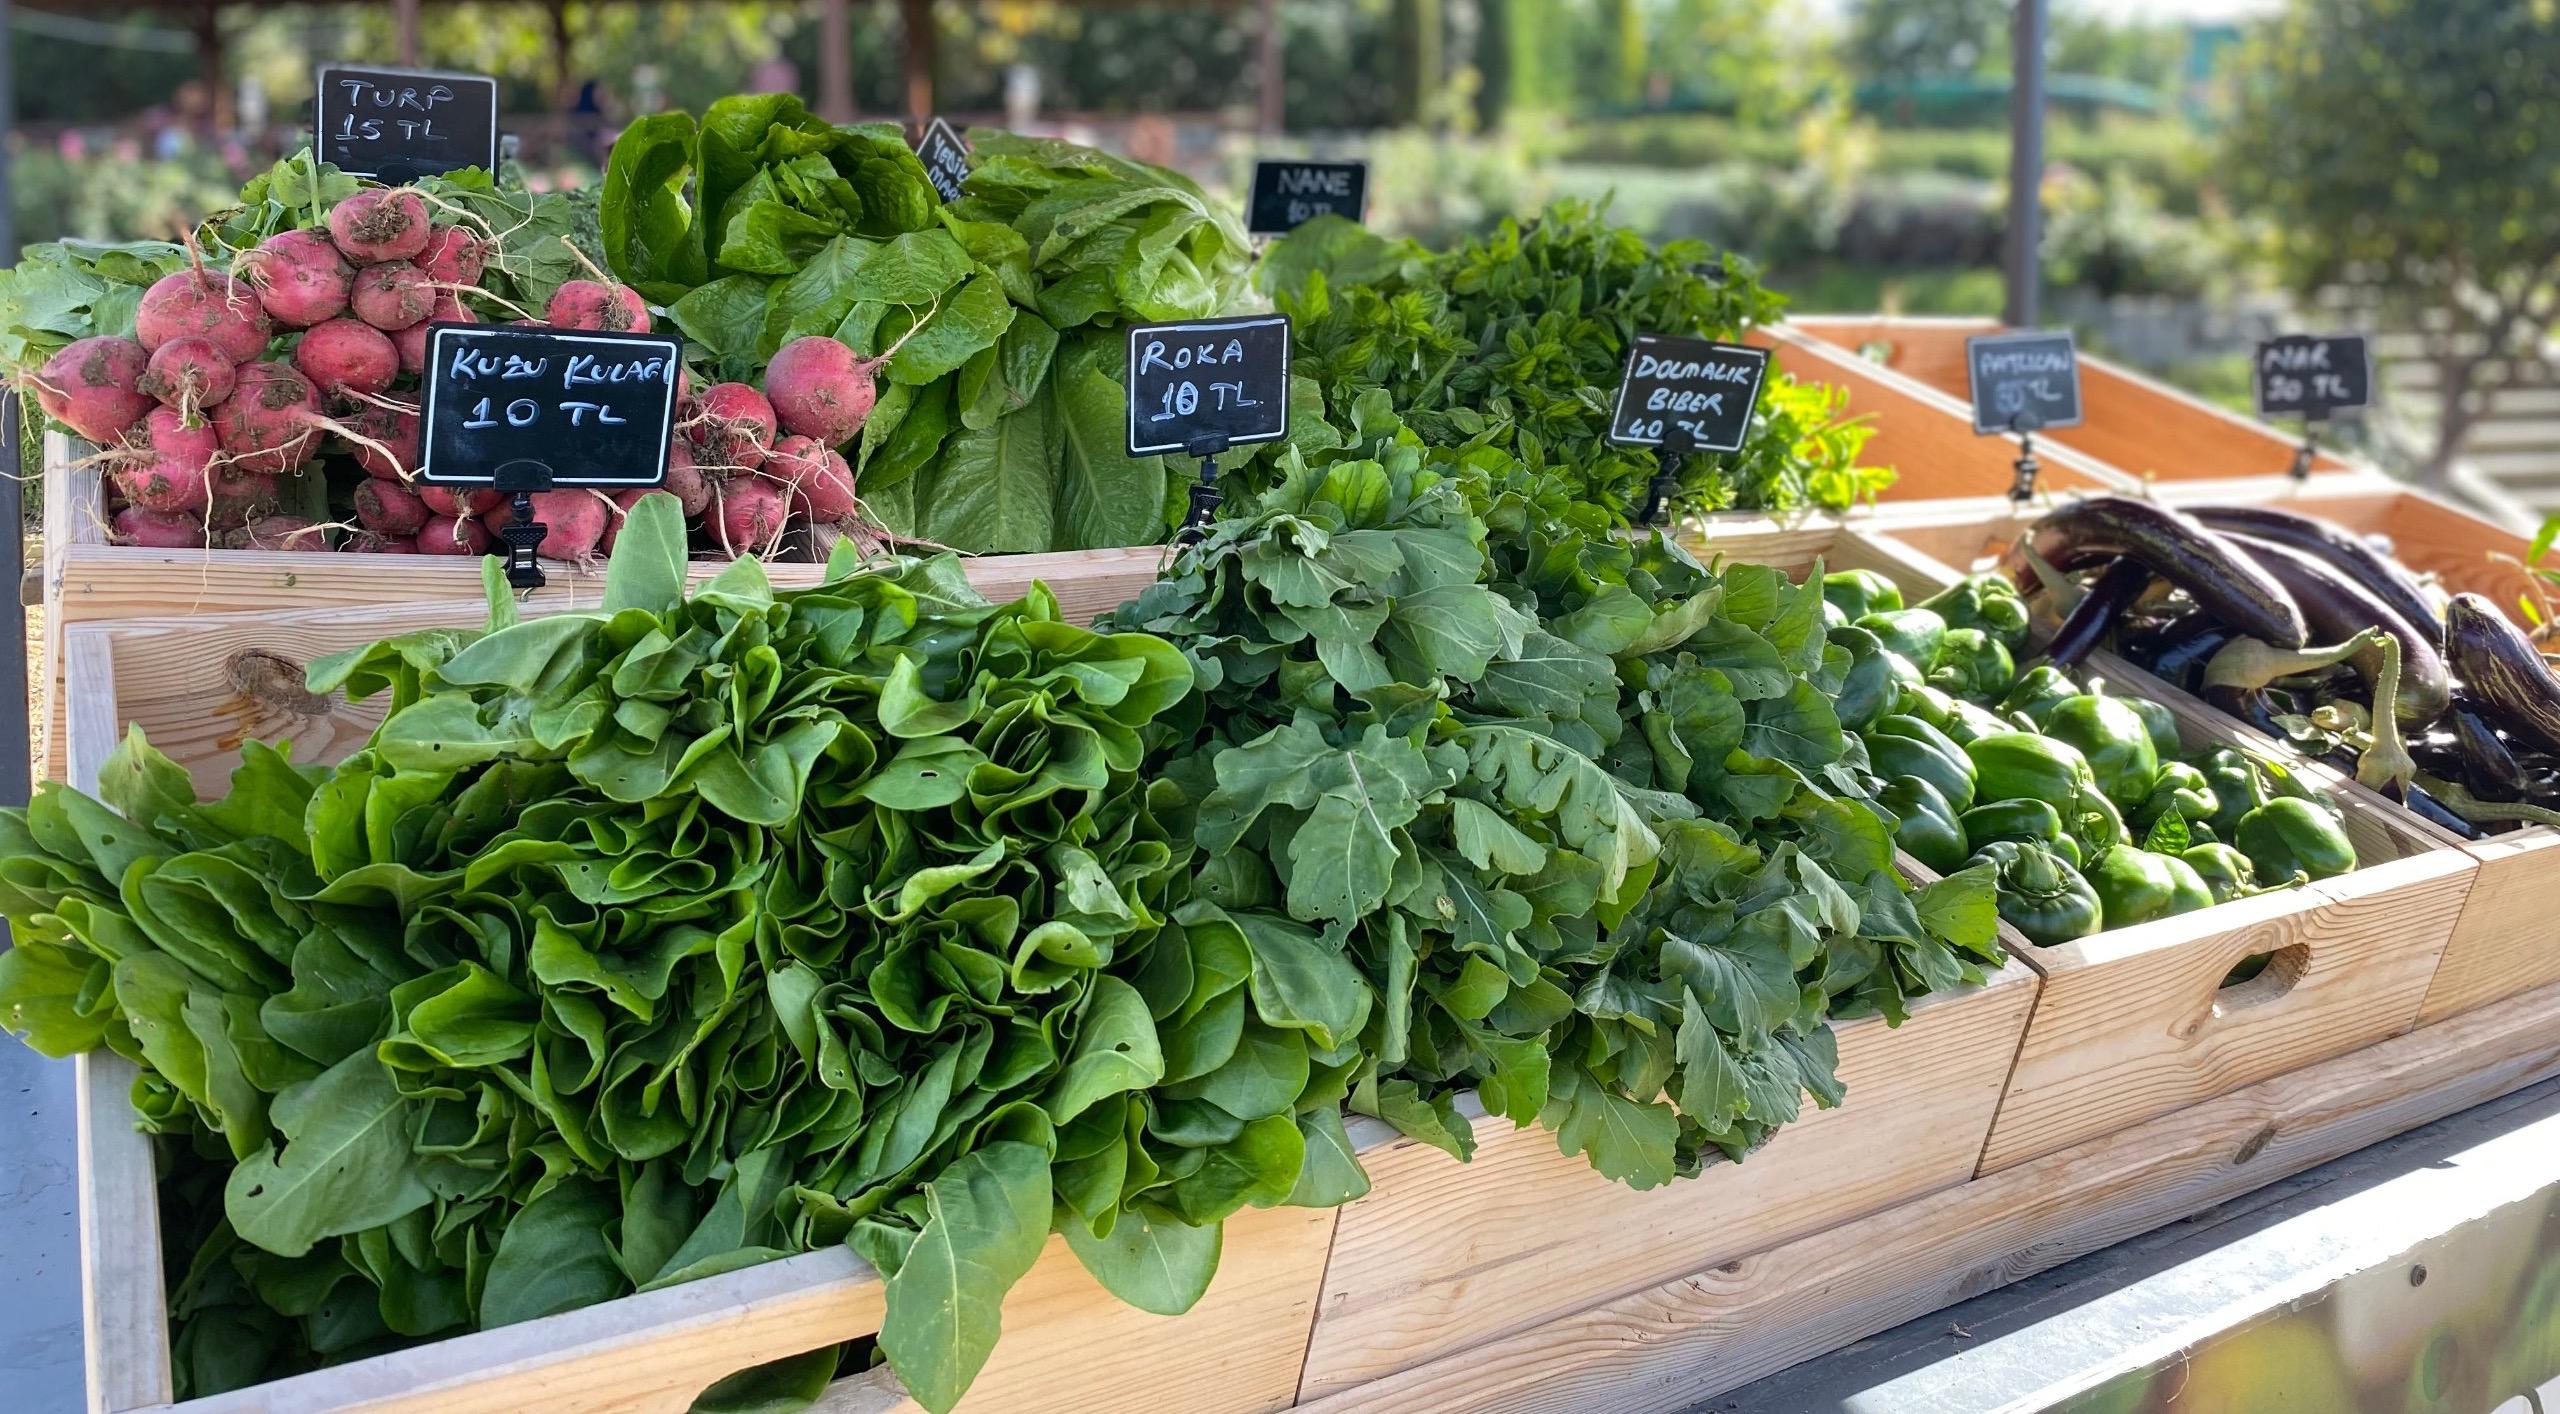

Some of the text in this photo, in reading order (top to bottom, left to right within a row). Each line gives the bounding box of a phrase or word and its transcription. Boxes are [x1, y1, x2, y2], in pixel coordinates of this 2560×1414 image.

[340, 79, 455, 112] TURP
[335, 113, 448, 141] 15 TL
[1277, 167, 1350, 196] NANE
[1288, 198, 1310, 223] 10
[1139, 339, 1243, 375] ROKA
[1635, 354, 1752, 386] DOLMALIK
[1980, 349, 2069, 376] PATLICAN
[2263, 341, 2331, 373] NAR
[2028, 378, 2063, 401] TL
[2311, 374, 2350, 399] TL
[463, 397, 627, 430] 10 TL
[1151, 381, 1198, 422] 10
[1628, 417, 1663, 439] 40
